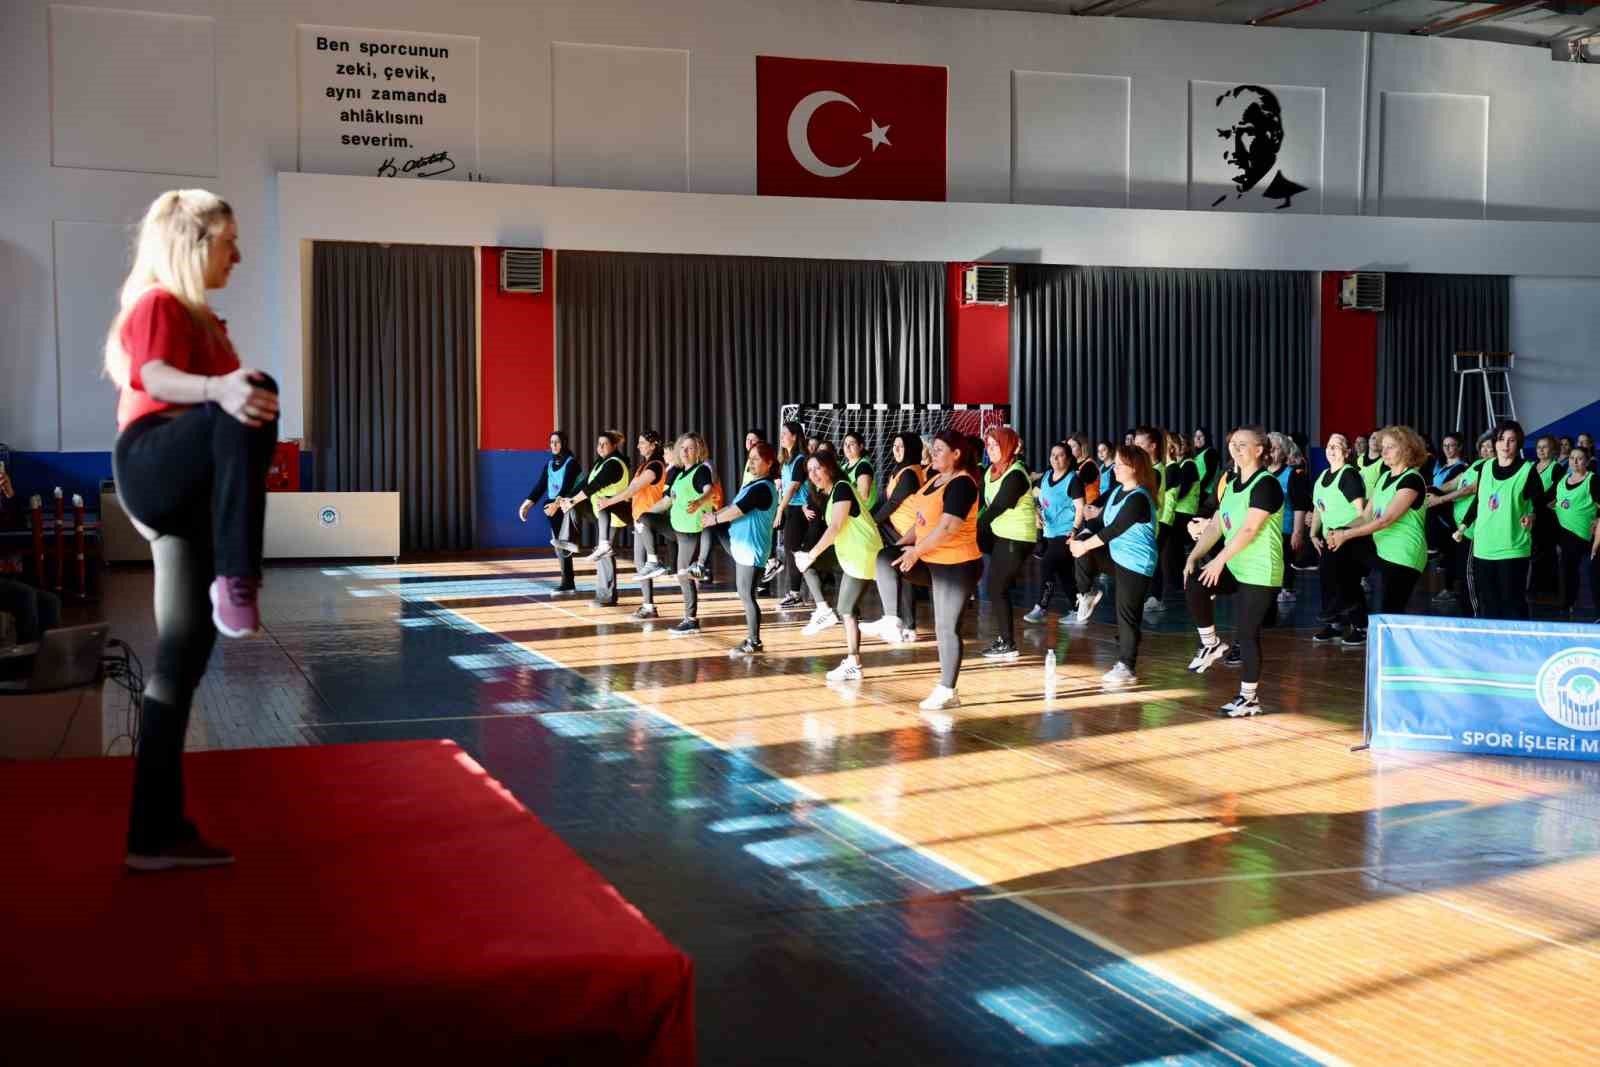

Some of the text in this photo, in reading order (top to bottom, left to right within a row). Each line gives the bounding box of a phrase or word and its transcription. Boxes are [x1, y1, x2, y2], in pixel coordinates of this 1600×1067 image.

[316, 36, 449, 58] Ben sporcunun
[336, 61, 436, 82] zeki, çevik,
[325, 86, 447, 104] aynı zamanda
[340, 109, 424, 125] ahlâklısını
[341, 132, 414, 149] severim.
[1462, 731, 1513, 748] SPOR
[1518, 731, 1576, 752] İŞLERİ
